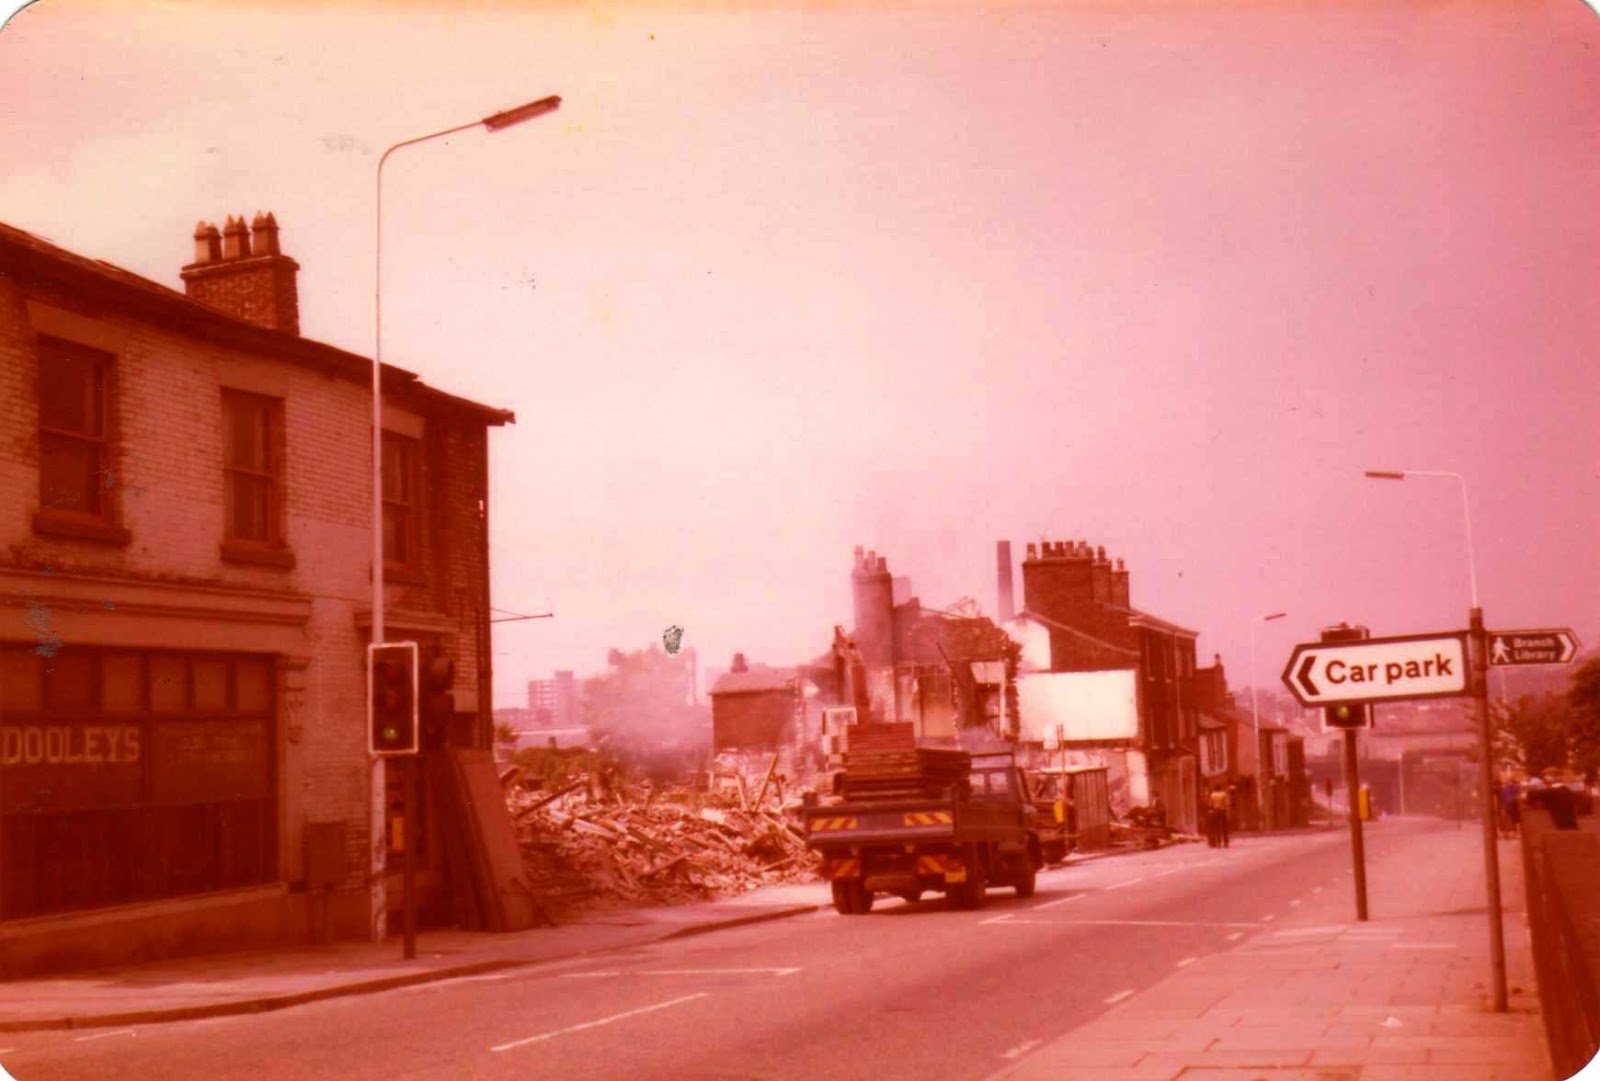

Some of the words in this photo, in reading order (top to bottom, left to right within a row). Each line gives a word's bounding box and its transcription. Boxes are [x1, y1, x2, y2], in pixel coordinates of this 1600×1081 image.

[1513, 637, 1555, 648] Branch
[1514, 649, 1556, 661] Library
[1325, 659, 1378, 685] Car
[1385, 653, 1453, 685] park
[1, 726, 140, 764] DOOLEYS
